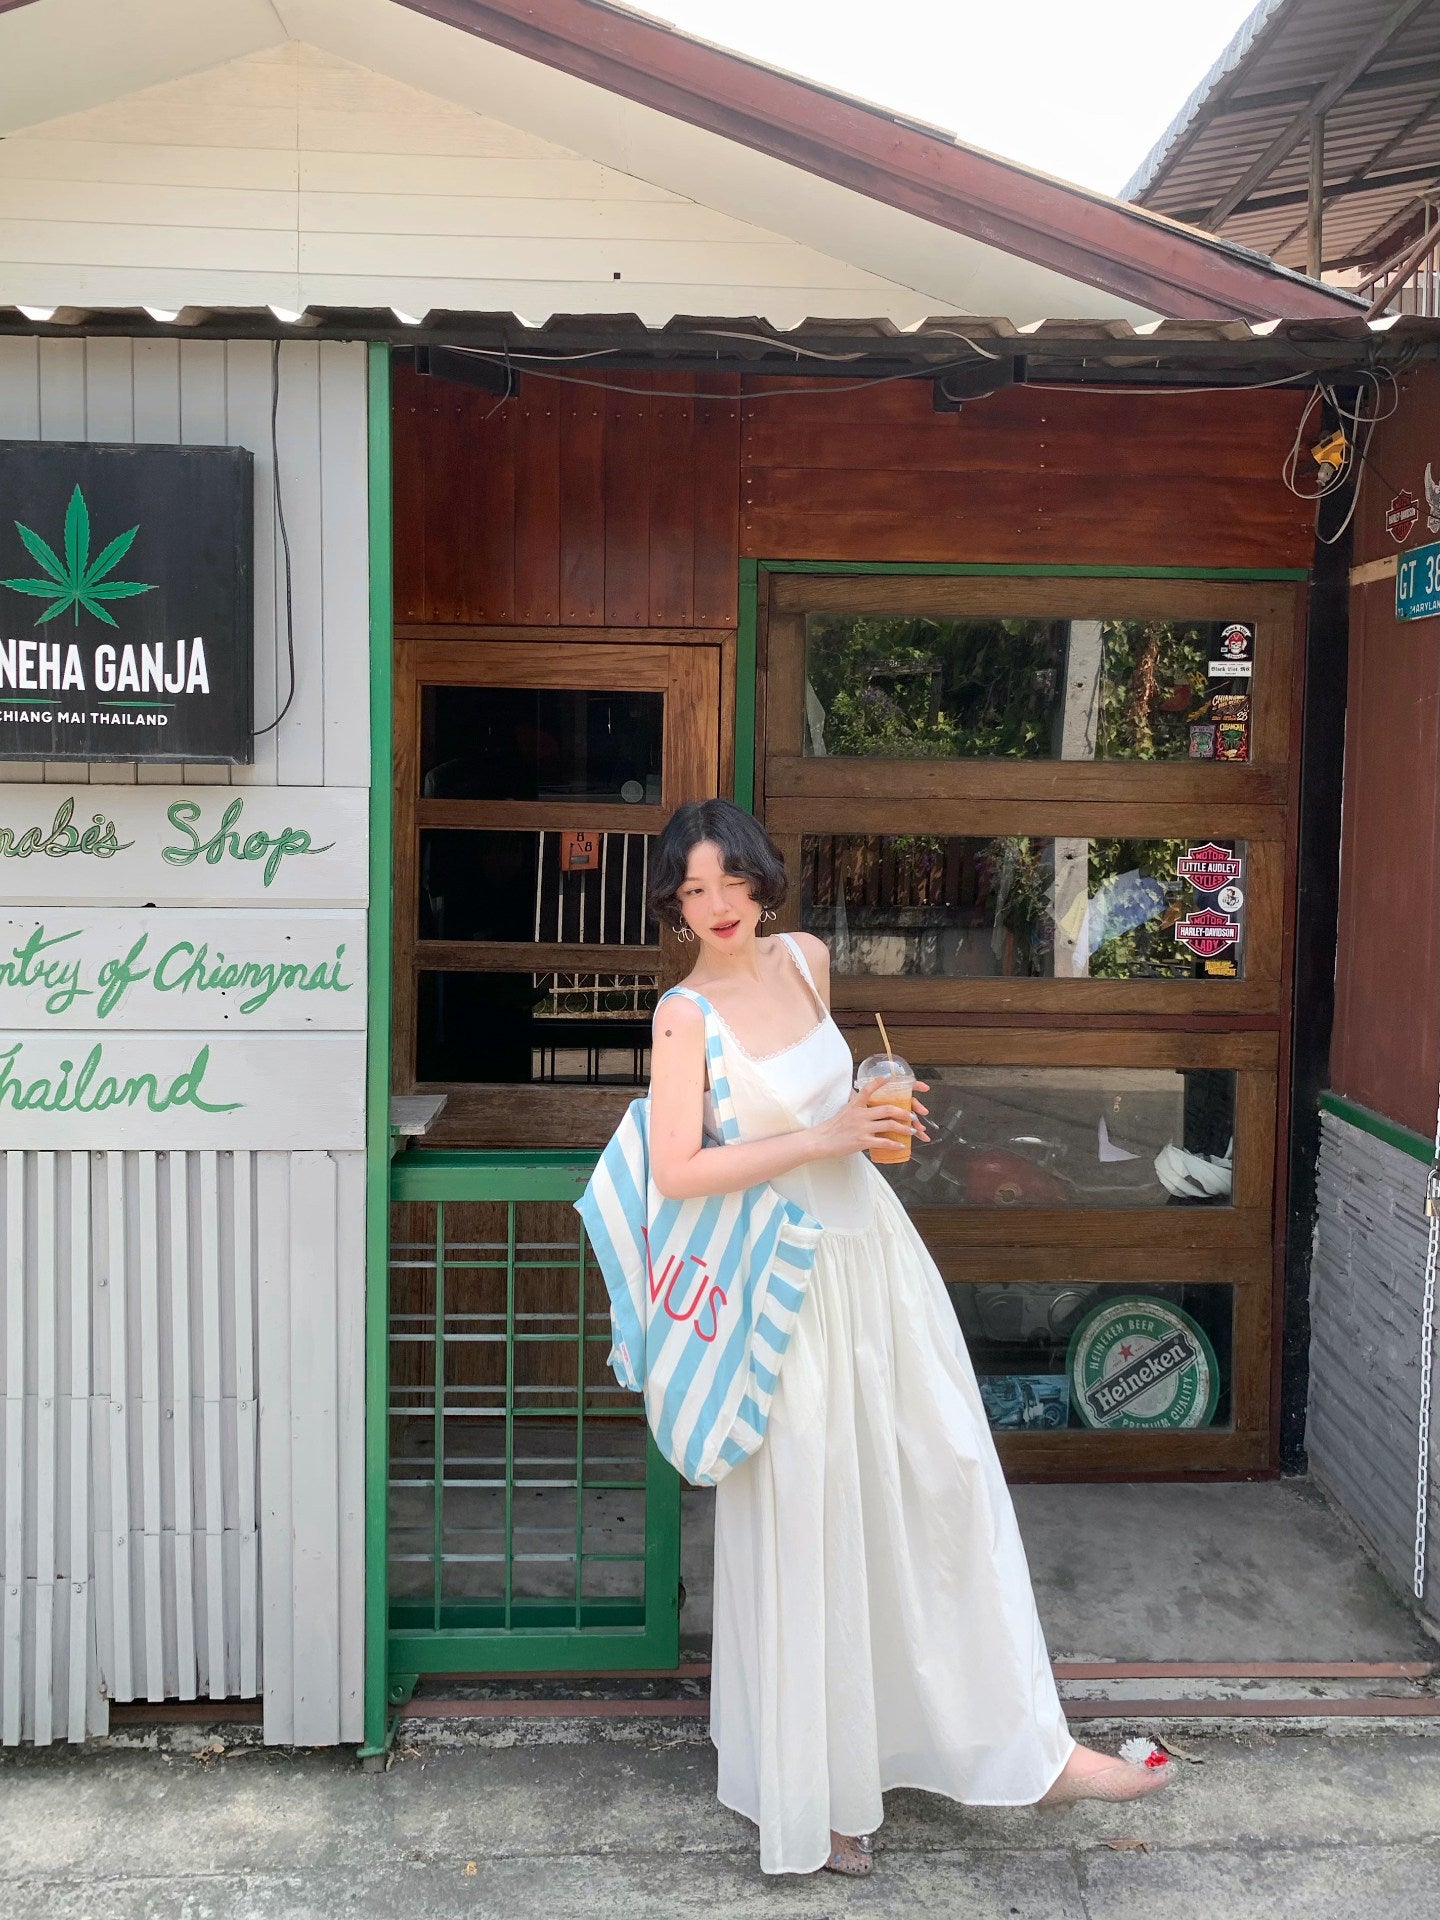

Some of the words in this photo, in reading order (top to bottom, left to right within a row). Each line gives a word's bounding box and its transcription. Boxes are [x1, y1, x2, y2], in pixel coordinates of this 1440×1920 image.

[1400, 560, 1416, 600] GT
[0, 638, 85, 691] NEHA
[94, 637, 209, 694] GANJA
[58, 712, 86, 724] MAI
[90, 713, 168, 726] THAILAND
[162, 798, 336, 887] Shop
[1195, 850, 1224, 861] MOTOR
[1182, 862, 1207, 872] LITTLE
[1207, 863, 1236, 873] AUDLEY
[1194, 875, 1223, 887] CYCLES
[1180, 926, 1235, 938] HARLEY-DAVIDSON
[1194, 915, 1223, 925] MOTOR
[1194, 939, 1220, 952] LADY
[97, 932, 151, 1019] of
[153, 941, 353, 1014] Chiangmai
[1090, 1322, 1124, 1369] HEINEKEN
[1128, 1319, 1154, 1332] BEER
[1095, 1344, 1187, 1412] Heineken
[1170, 1376, 1193, 1420] QUALITY
